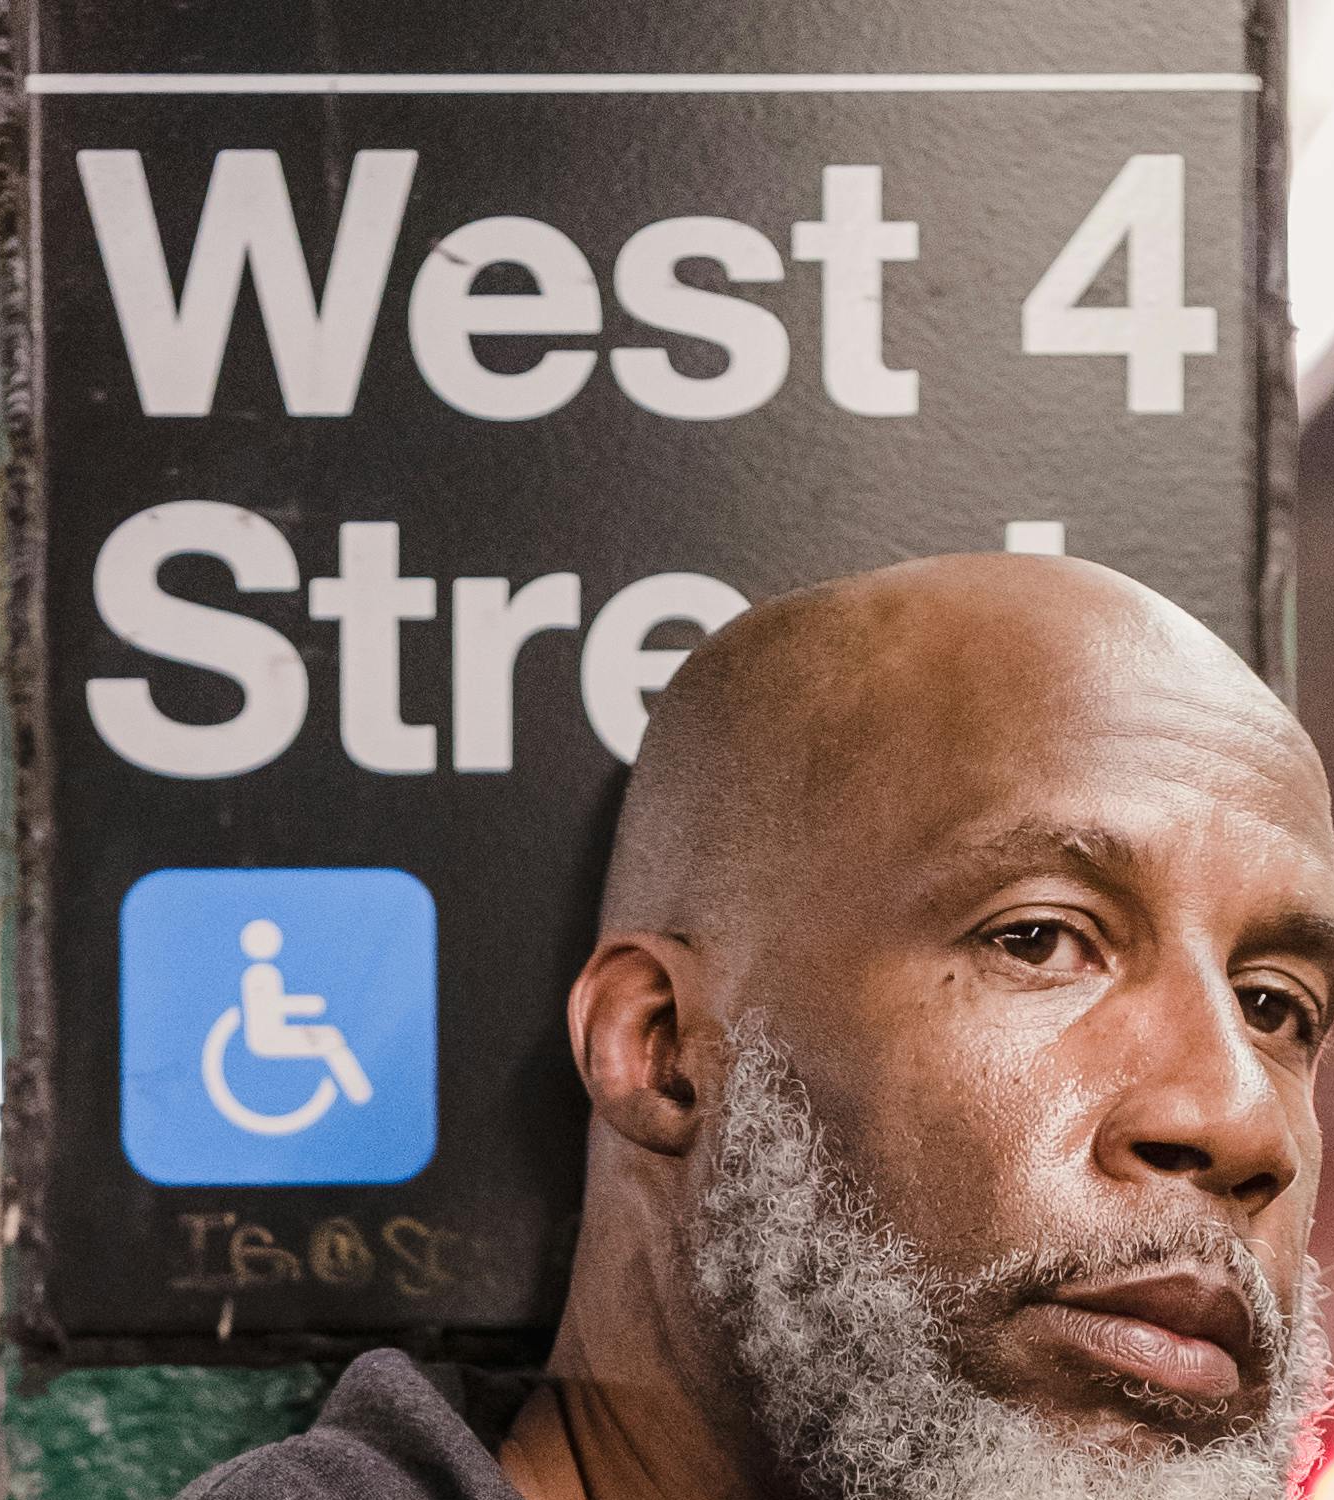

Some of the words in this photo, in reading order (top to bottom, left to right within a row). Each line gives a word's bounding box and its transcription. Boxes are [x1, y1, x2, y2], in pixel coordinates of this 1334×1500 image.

[76, 148, 920, 421] West
[1020, 152, 1218, 415] 4
[85, 500, 1067, 779] Stre
